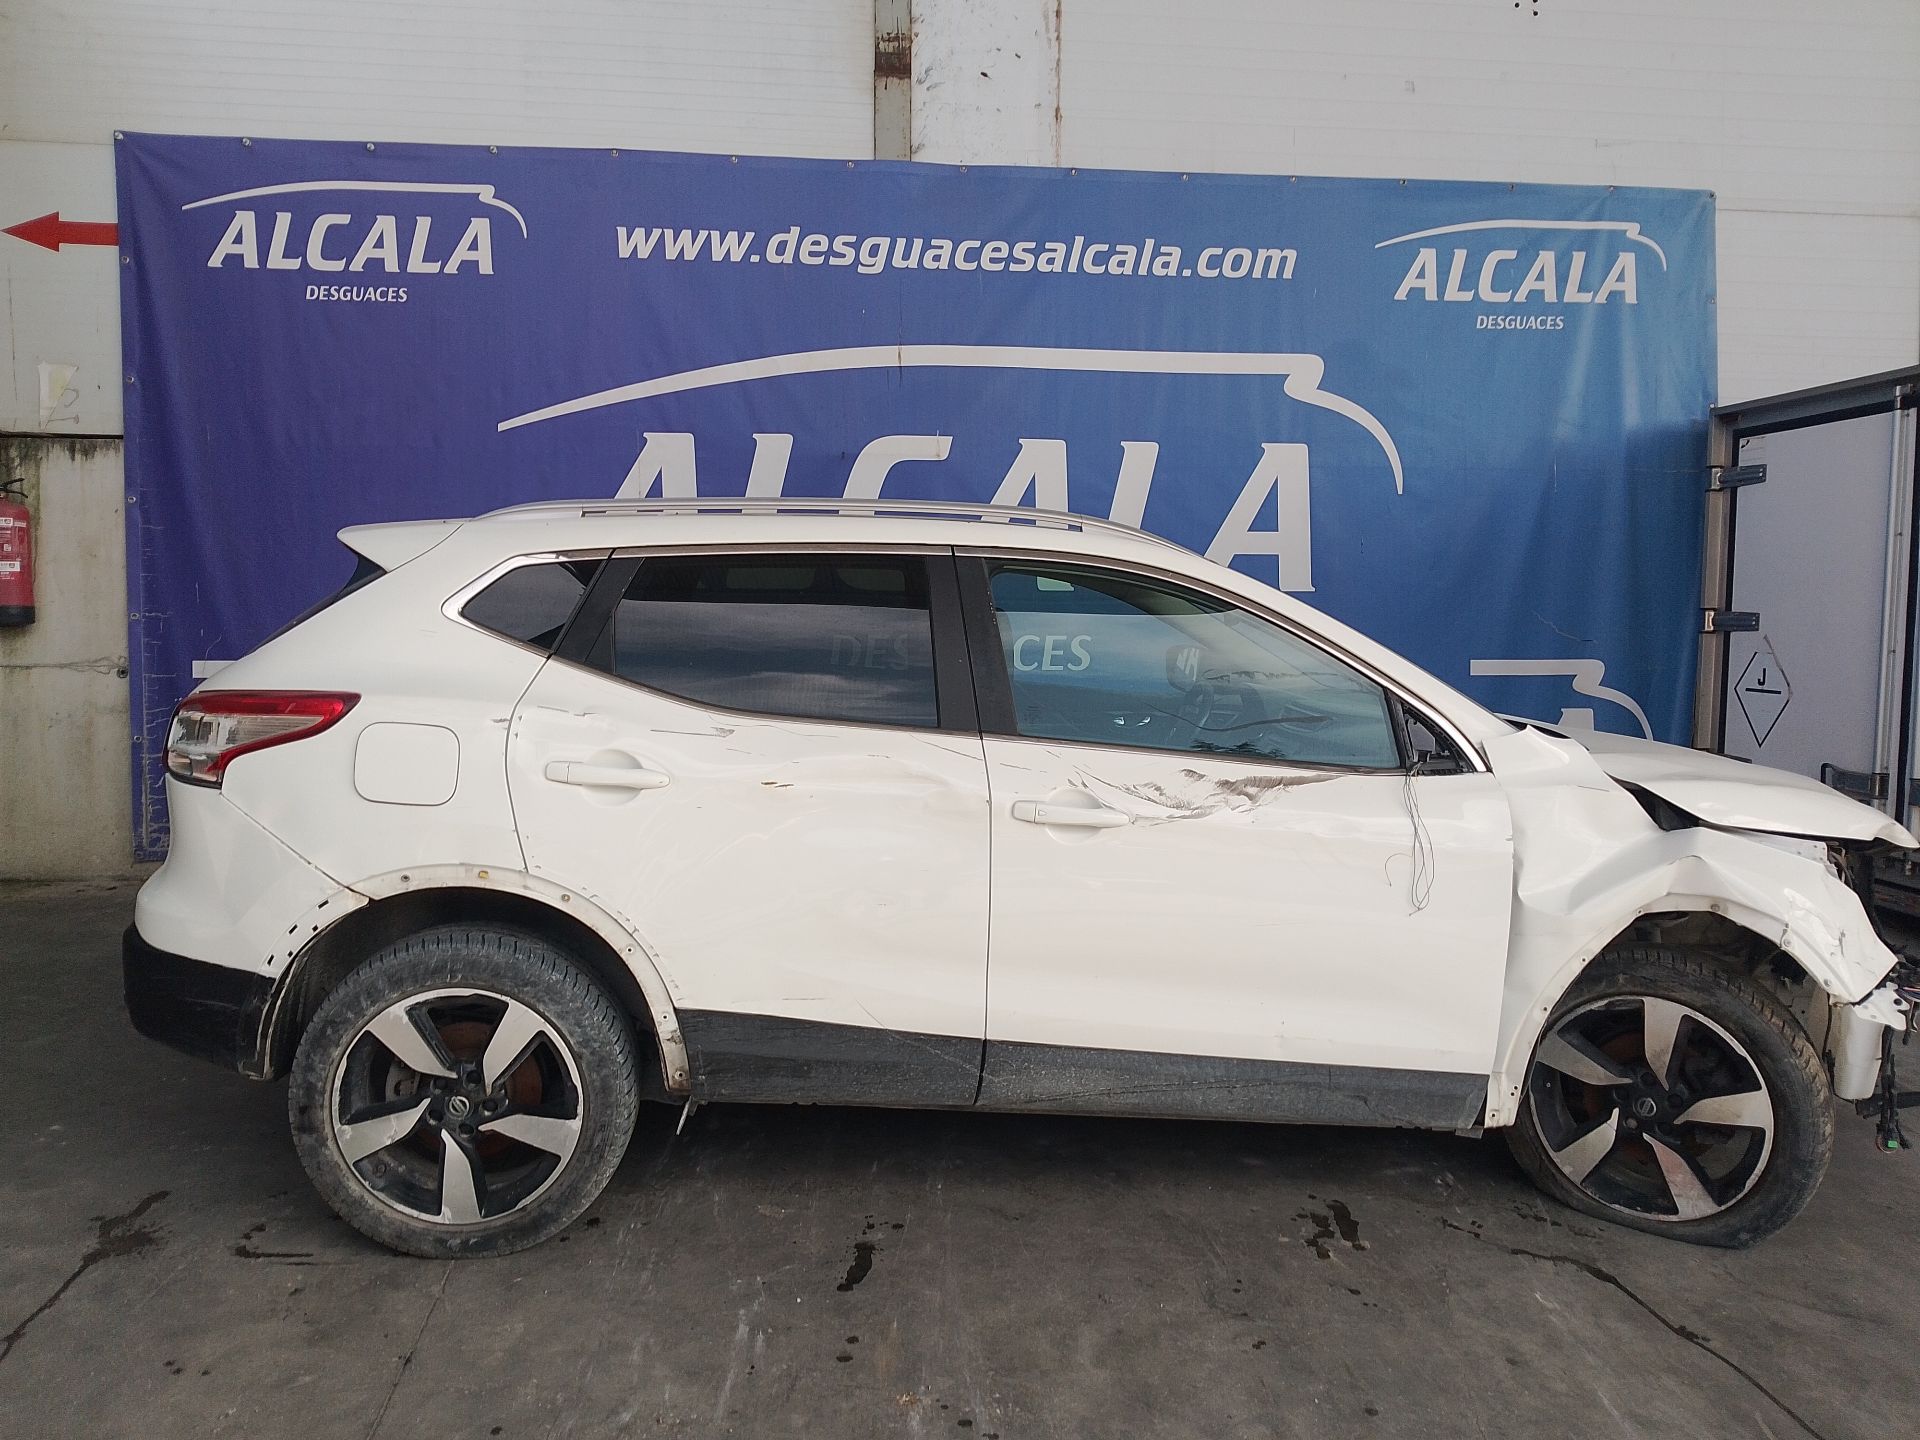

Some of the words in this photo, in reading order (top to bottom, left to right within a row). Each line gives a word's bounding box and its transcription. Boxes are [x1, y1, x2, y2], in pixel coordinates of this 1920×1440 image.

[207, 210, 494, 275] ALCALA
[615, 225, 1298, 280] www.desguacesalcala.com
[305, 285, 408, 303] DESGUACES
[1393, 247, 1638, 305] ALCALA
[1475, 314, 1565, 331] DESGUACES
